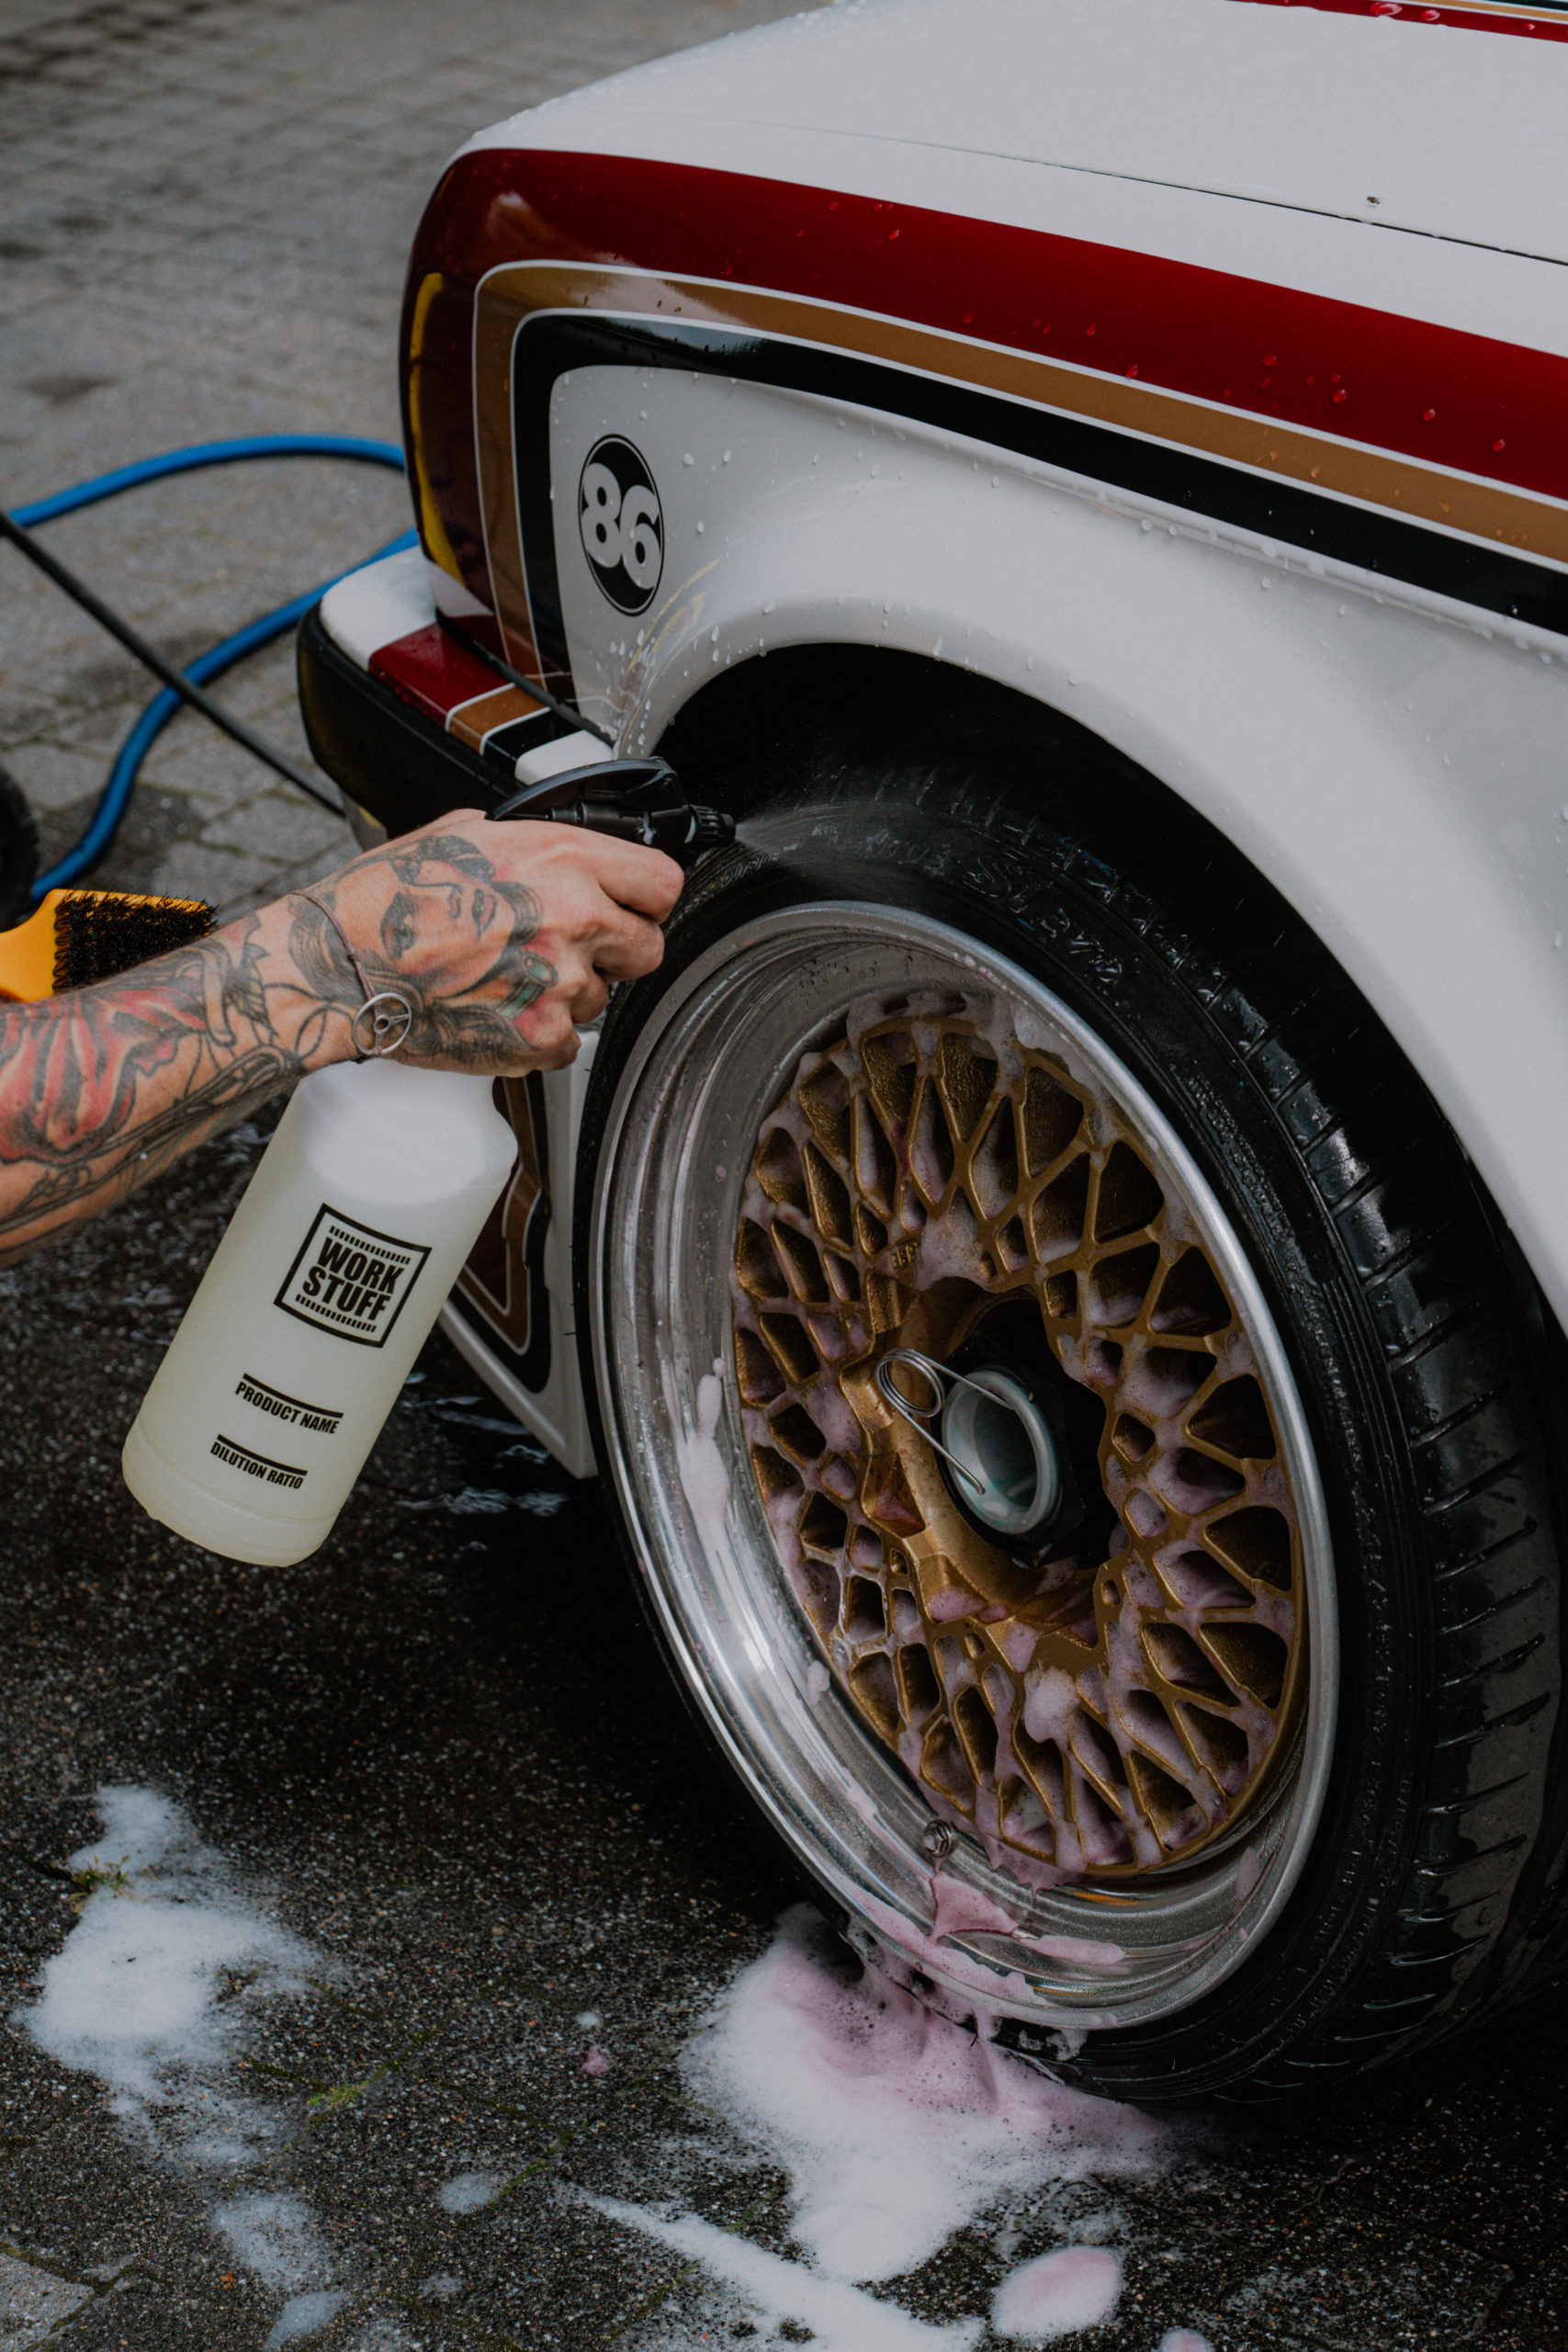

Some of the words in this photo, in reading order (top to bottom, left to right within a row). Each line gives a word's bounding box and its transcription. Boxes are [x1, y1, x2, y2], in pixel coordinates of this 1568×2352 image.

[581, 462, 661, 590] 86
[302, 1265, 391, 1321] STUFF
[317, 1237, 404, 1295] WORK
[235, 1381, 301, 1423] PRODUCT
[299, 1413, 340, 1434] NAME
[210, 1442, 267, 1478] DILUTION
[266, 1470, 304, 1489] RATIO
